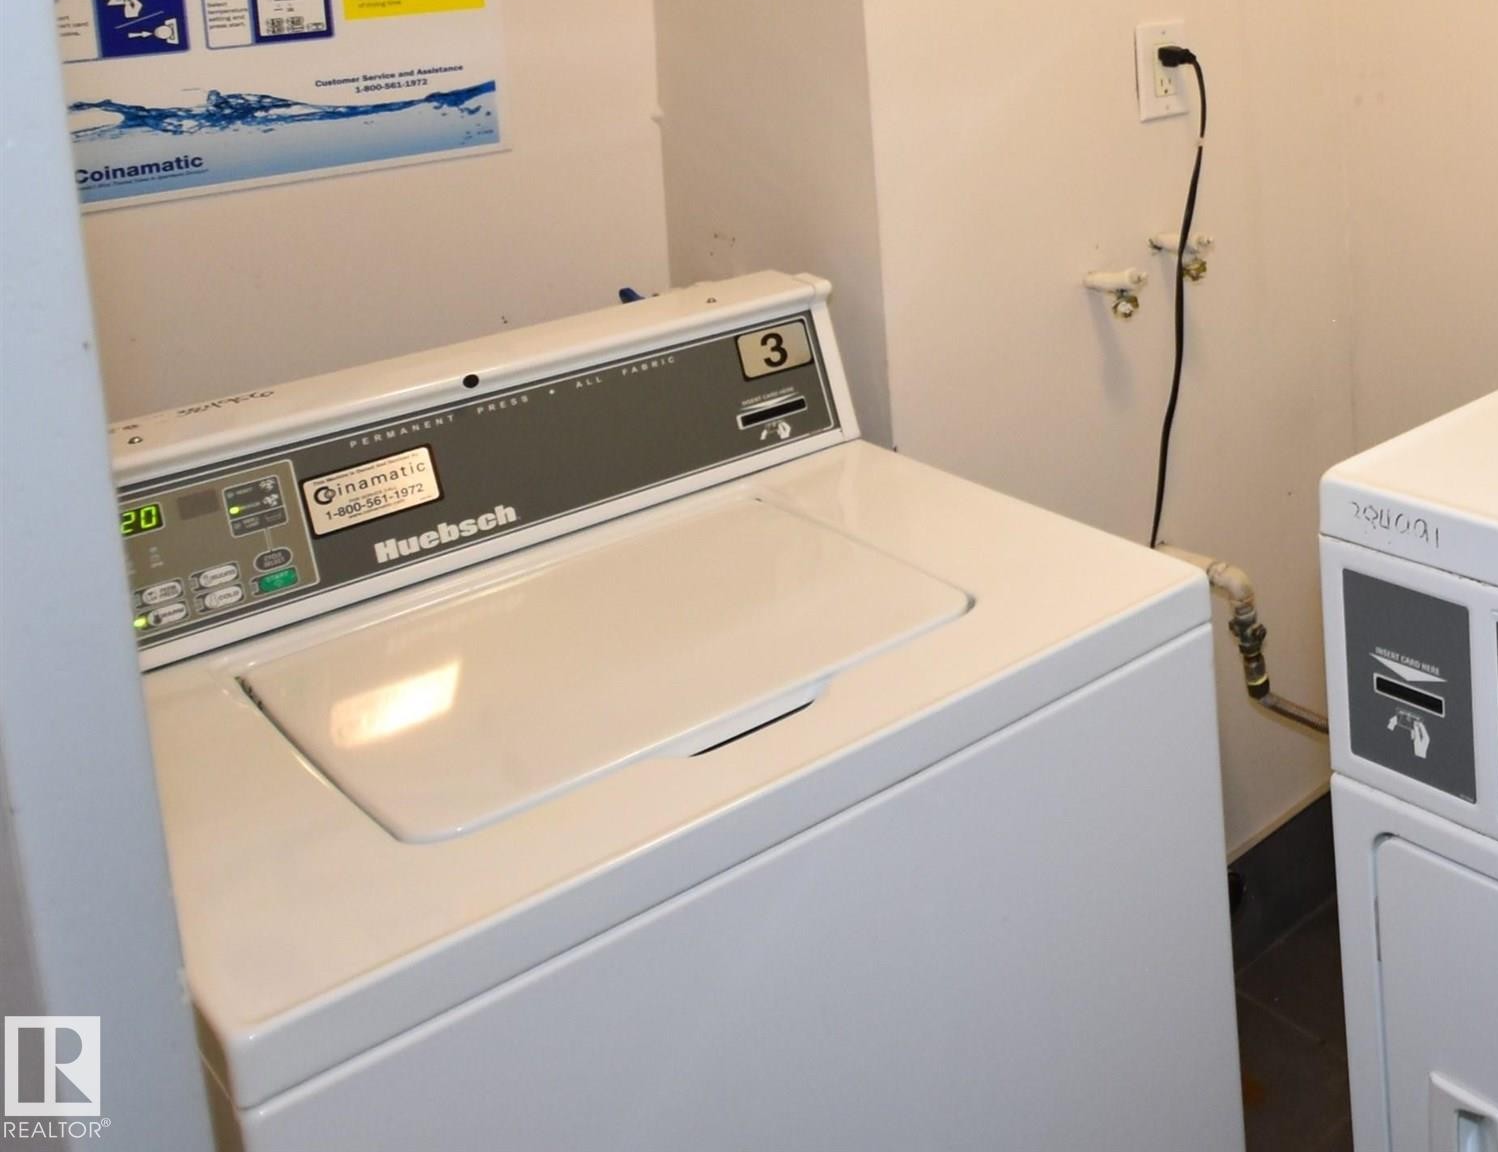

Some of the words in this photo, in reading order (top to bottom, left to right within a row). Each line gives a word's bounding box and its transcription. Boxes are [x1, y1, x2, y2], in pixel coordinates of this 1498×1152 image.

[315, 75, 360, 88] Customer
[362, 72, 396, 83] Service
[398, 70, 414, 78] and
[417, 64, 463, 75] Assistance
[355, 78, 428, 94] 1-800-561-1972
[75, 155, 203, 184] Coinamatic
[761, 333, 788, 367] 3
[350, 415, 454, 448] PERMANENT
[477, 395, 529, 416] PRESS
[576, 376, 603, 389] ALL
[622, 356, 676, 376] FABRIC
[326, 483, 424, 521] 1-800-561-1972
[374, 504, 517, 563] Huebsch
[1375, 647, 1400, 661] INSERT
[1401, 655, 1420, 669] CARD
[1421, 662, 1440, 676] HERE
